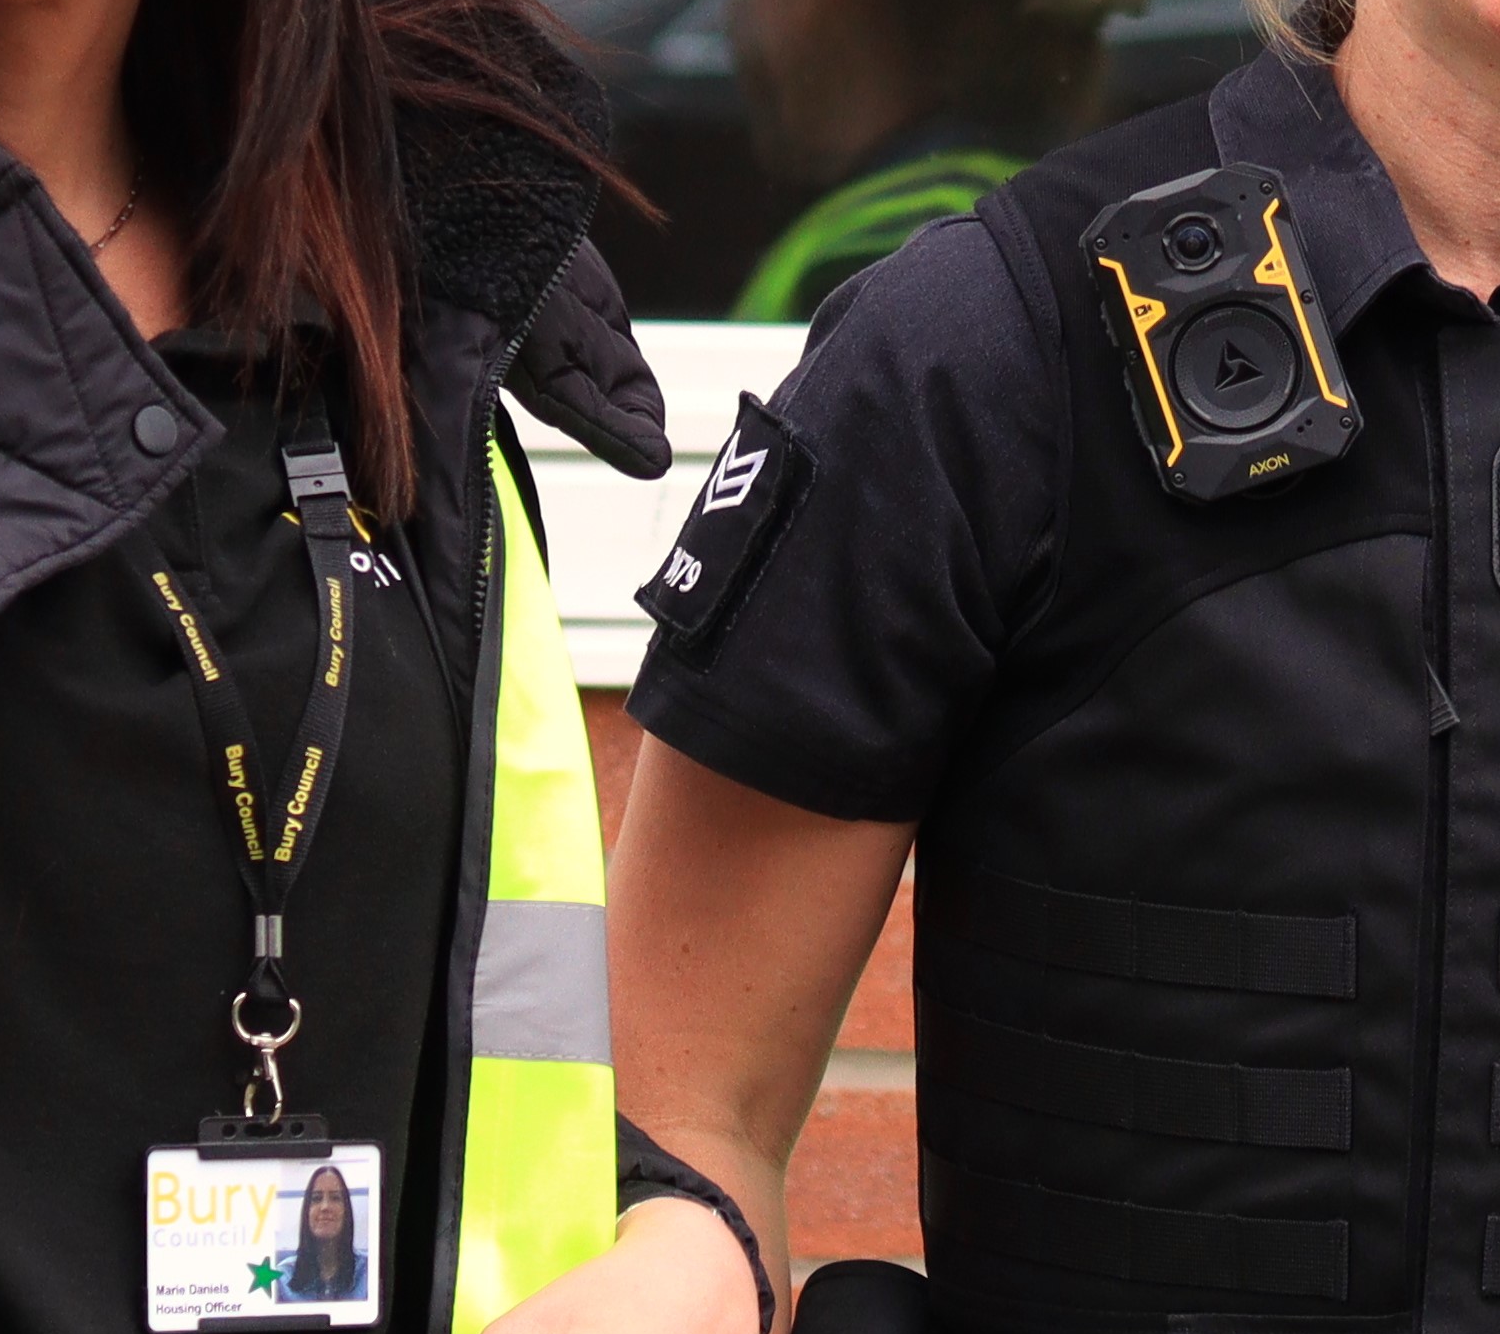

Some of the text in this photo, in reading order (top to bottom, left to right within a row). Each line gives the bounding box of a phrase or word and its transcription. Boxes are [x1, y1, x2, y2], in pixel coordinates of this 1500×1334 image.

[1249, 453, 1291, 479] AXON
[152, 571, 221, 682] Bury Council
[325, 576, 345, 688] Bury Council
[225, 744, 265, 861] Bury Council
[273, 746, 324, 862] Bury Council
[152, 1171, 278, 1245] Bury
[153, 1225, 247, 1248] Council
[156, 1283, 230, 1296] Marie Daniels
[156, 1301, 243, 1316] Housing Officer
